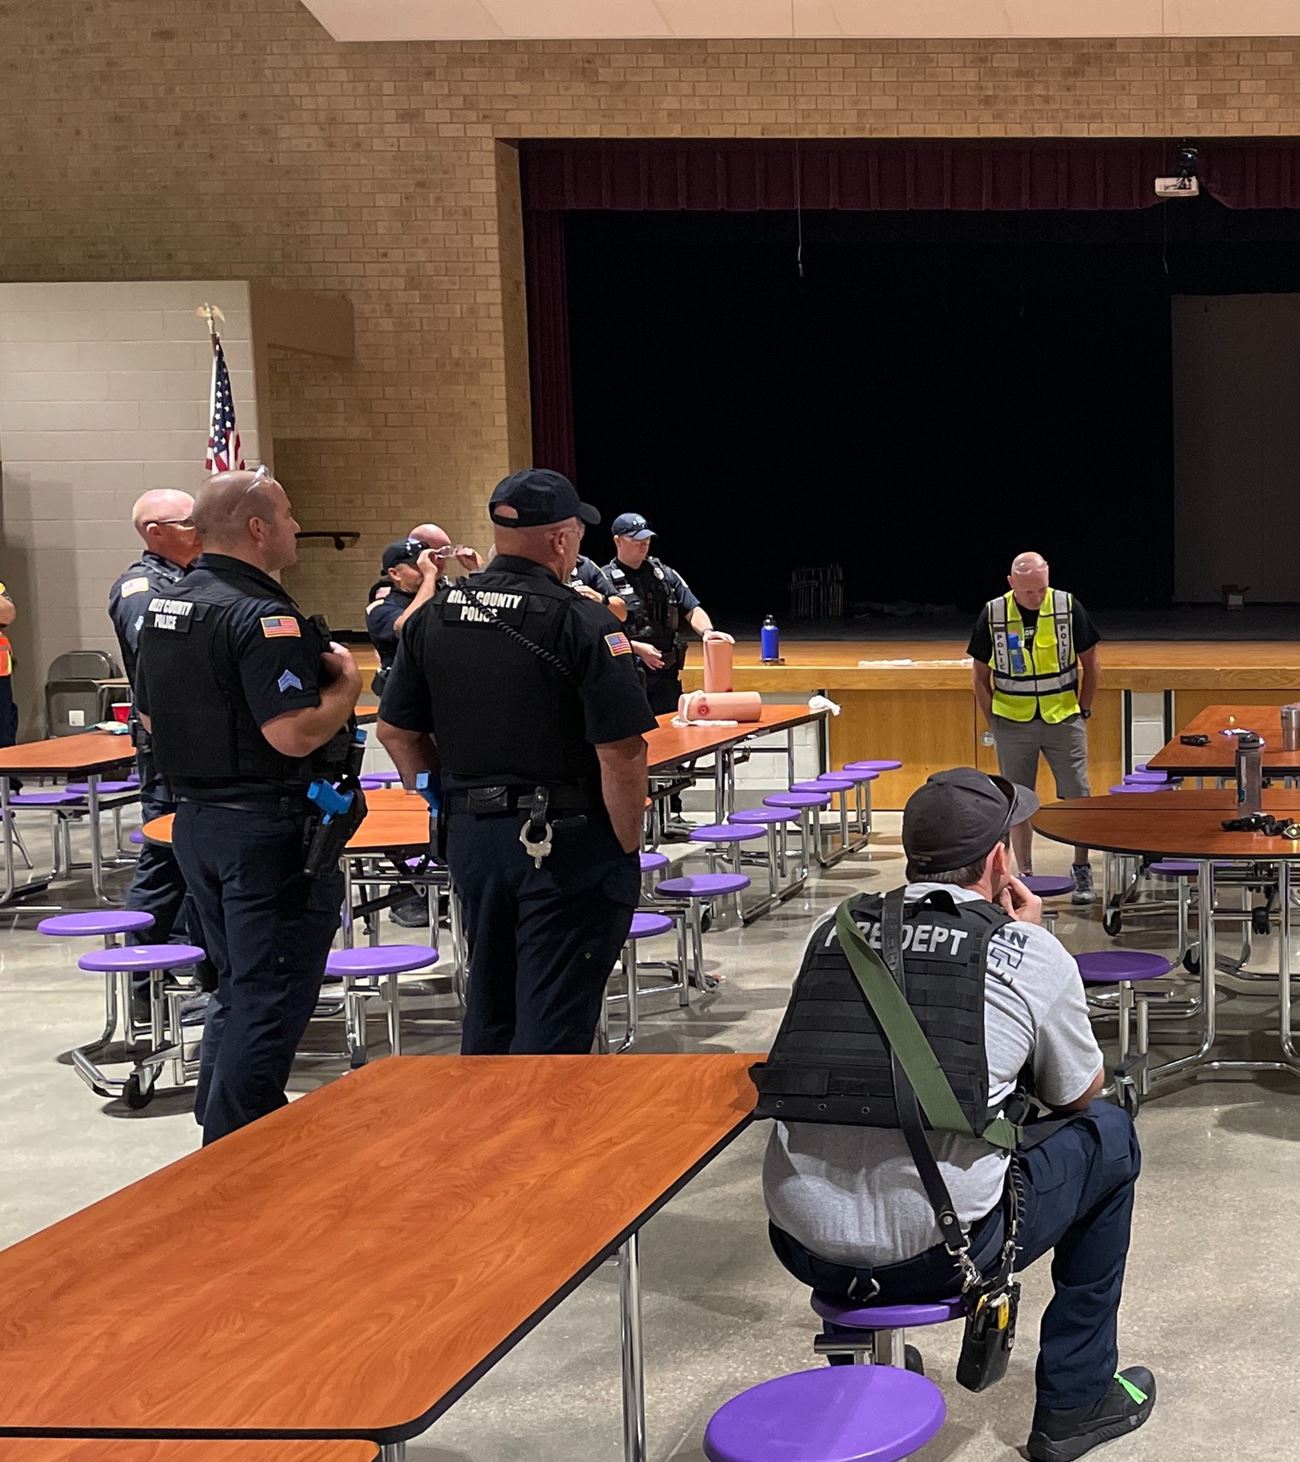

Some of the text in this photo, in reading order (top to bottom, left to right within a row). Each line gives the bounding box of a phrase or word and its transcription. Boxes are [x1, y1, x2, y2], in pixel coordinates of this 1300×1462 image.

[154, 613, 177, 630] POLICE
[996, 634, 1007, 670] POLIC
[900, 921, 969, 957] DEPT
